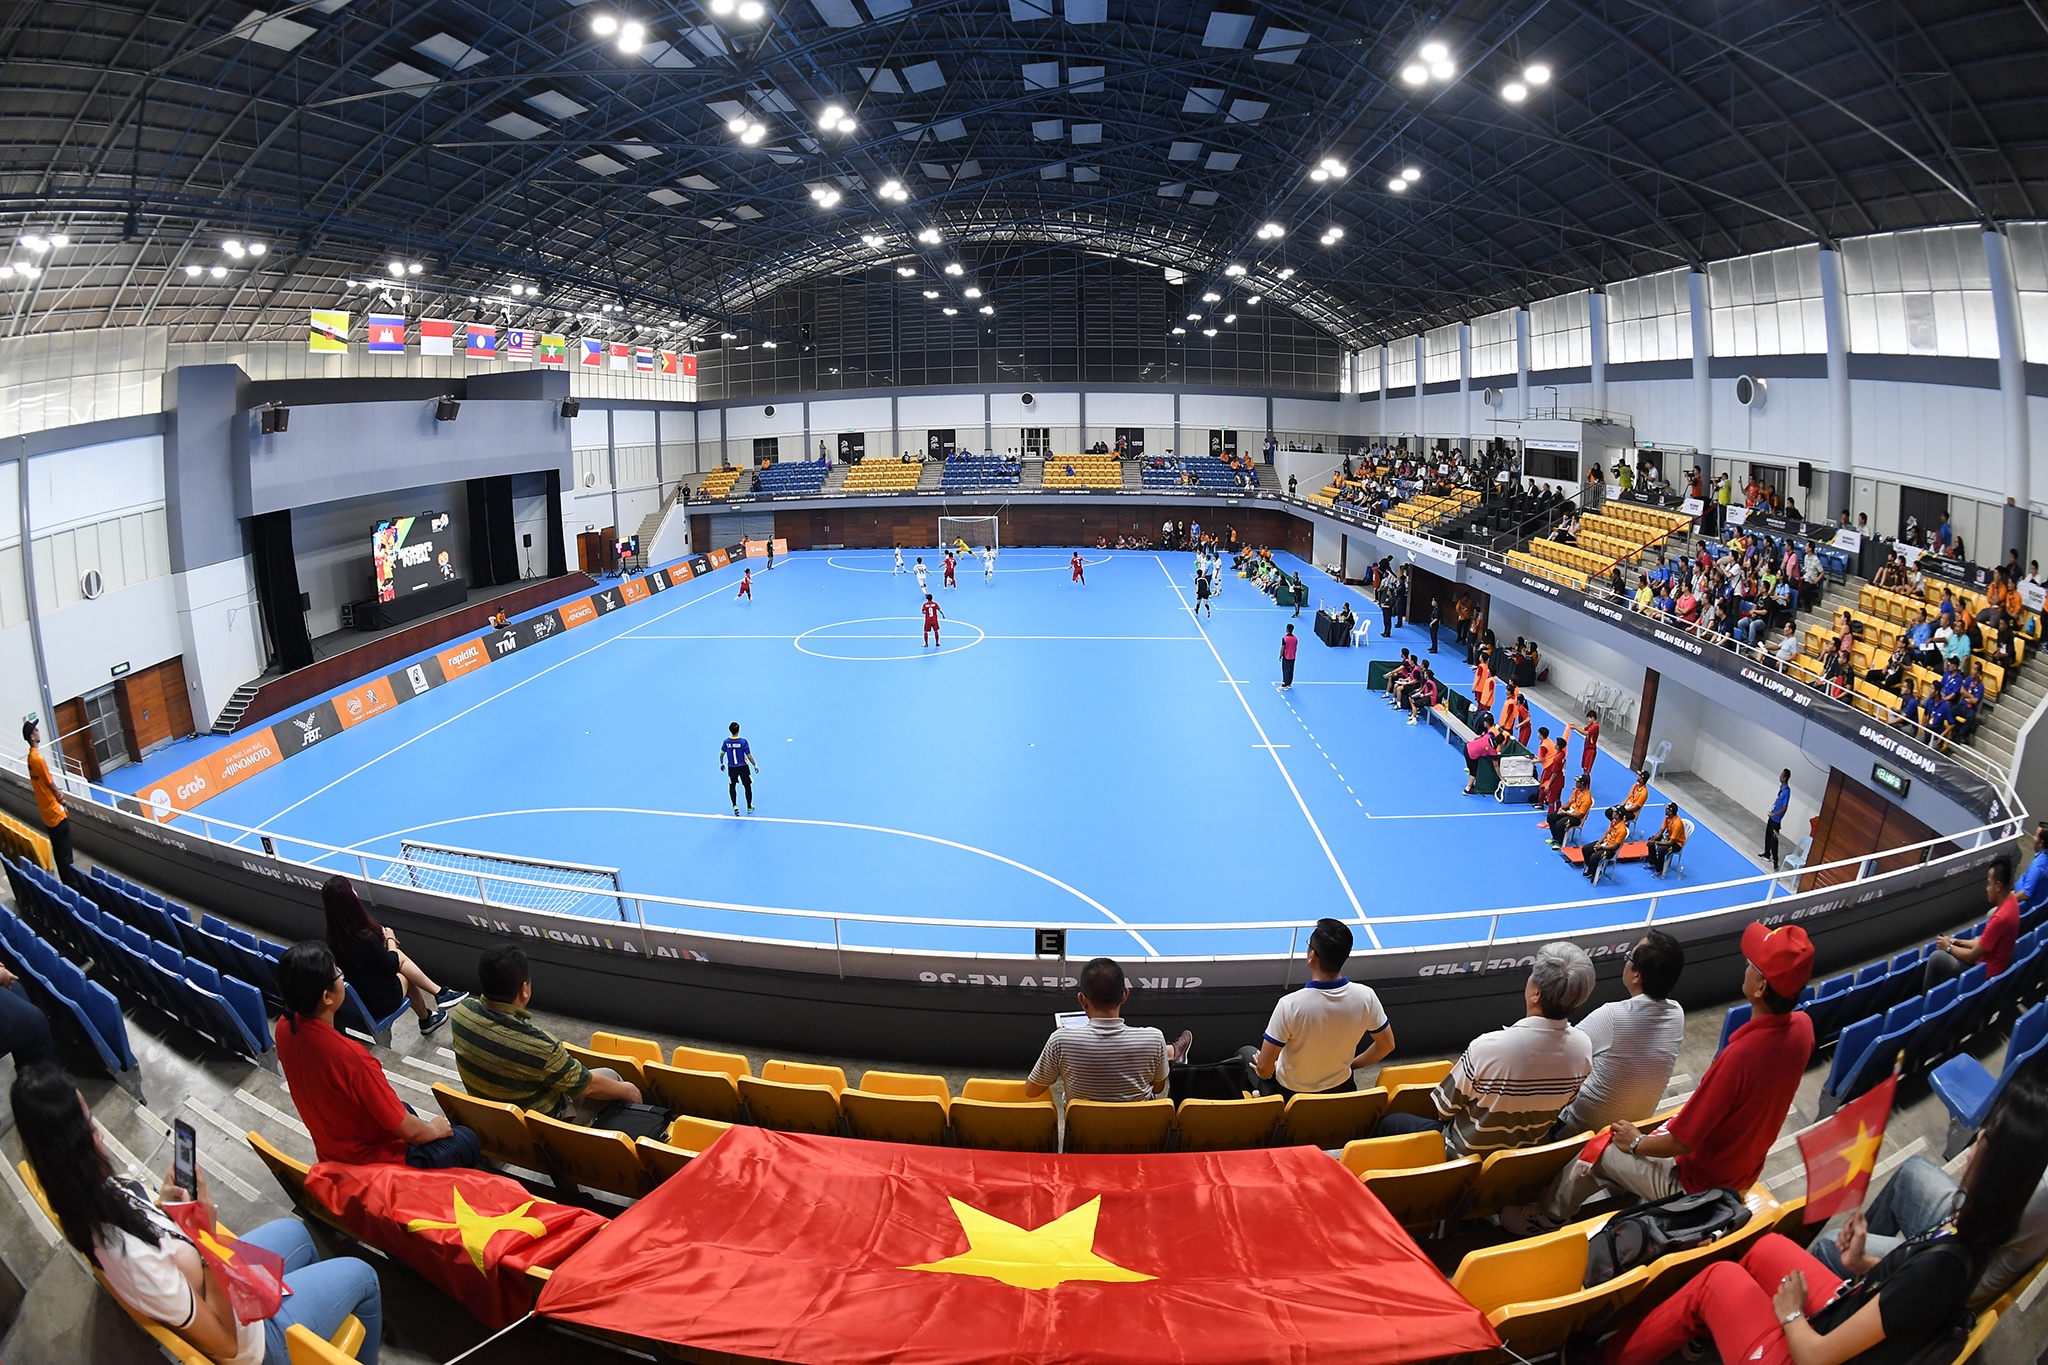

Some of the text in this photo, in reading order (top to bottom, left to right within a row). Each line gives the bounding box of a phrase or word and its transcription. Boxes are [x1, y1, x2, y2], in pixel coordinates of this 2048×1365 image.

[402, 551, 431, 568] FUTSAL
[928, 607, 933, 617] 9
[495, 638, 517, 654] TM
[1653, 629, 1702, 656] SUKAN SEA KE-29
[448, 646, 479, 667] rapidKL
[1740, 667, 1812, 707] KUALA LUMPUR 2017
[732, 748, 738, 765] 1
[1859, 724, 1937, 773] BANGKIT BERSAMA
[222, 747, 270, 779] AJINOMOTO
[176, 774, 206, 800] Grab
[264, 839, 272, 853] D
[1041, 933, 1058, 950] E
